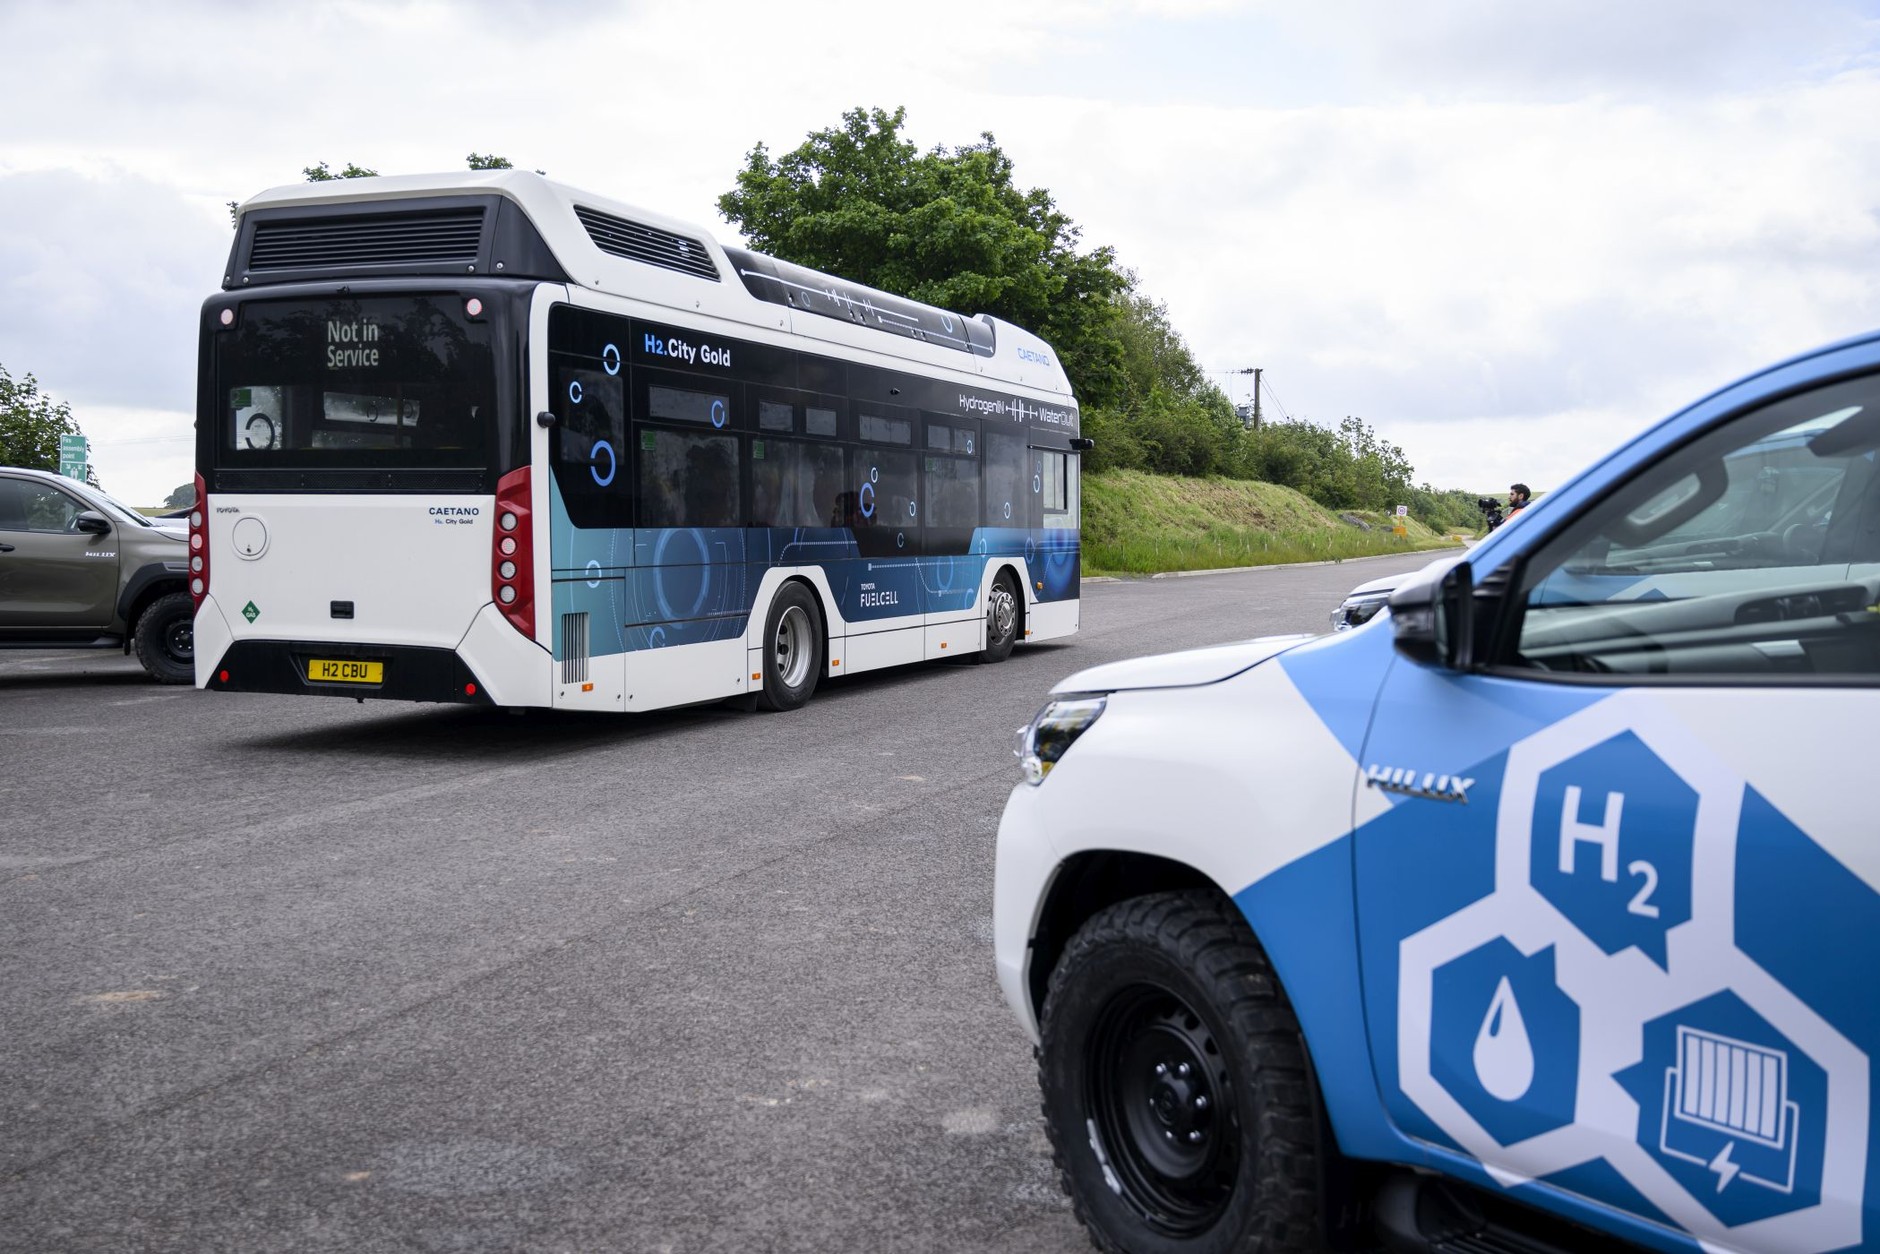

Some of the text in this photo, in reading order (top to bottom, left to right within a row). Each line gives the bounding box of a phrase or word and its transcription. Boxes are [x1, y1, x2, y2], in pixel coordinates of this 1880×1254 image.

[328, 318, 379, 342] Not in
[327, 343, 379, 367] Service
[700, 344, 731, 367] Gold
[1017, 347, 1051, 367] CAETANO
[216, 506, 240, 514] TOYOTA
[428, 507, 480, 516] CAETANO
[860, 591, 898, 607] FUELCELL
[322, 662, 368, 679] H2 CBU
[1366, 763, 1476, 805] HILUX
[1558, 784, 1661, 920] H2
